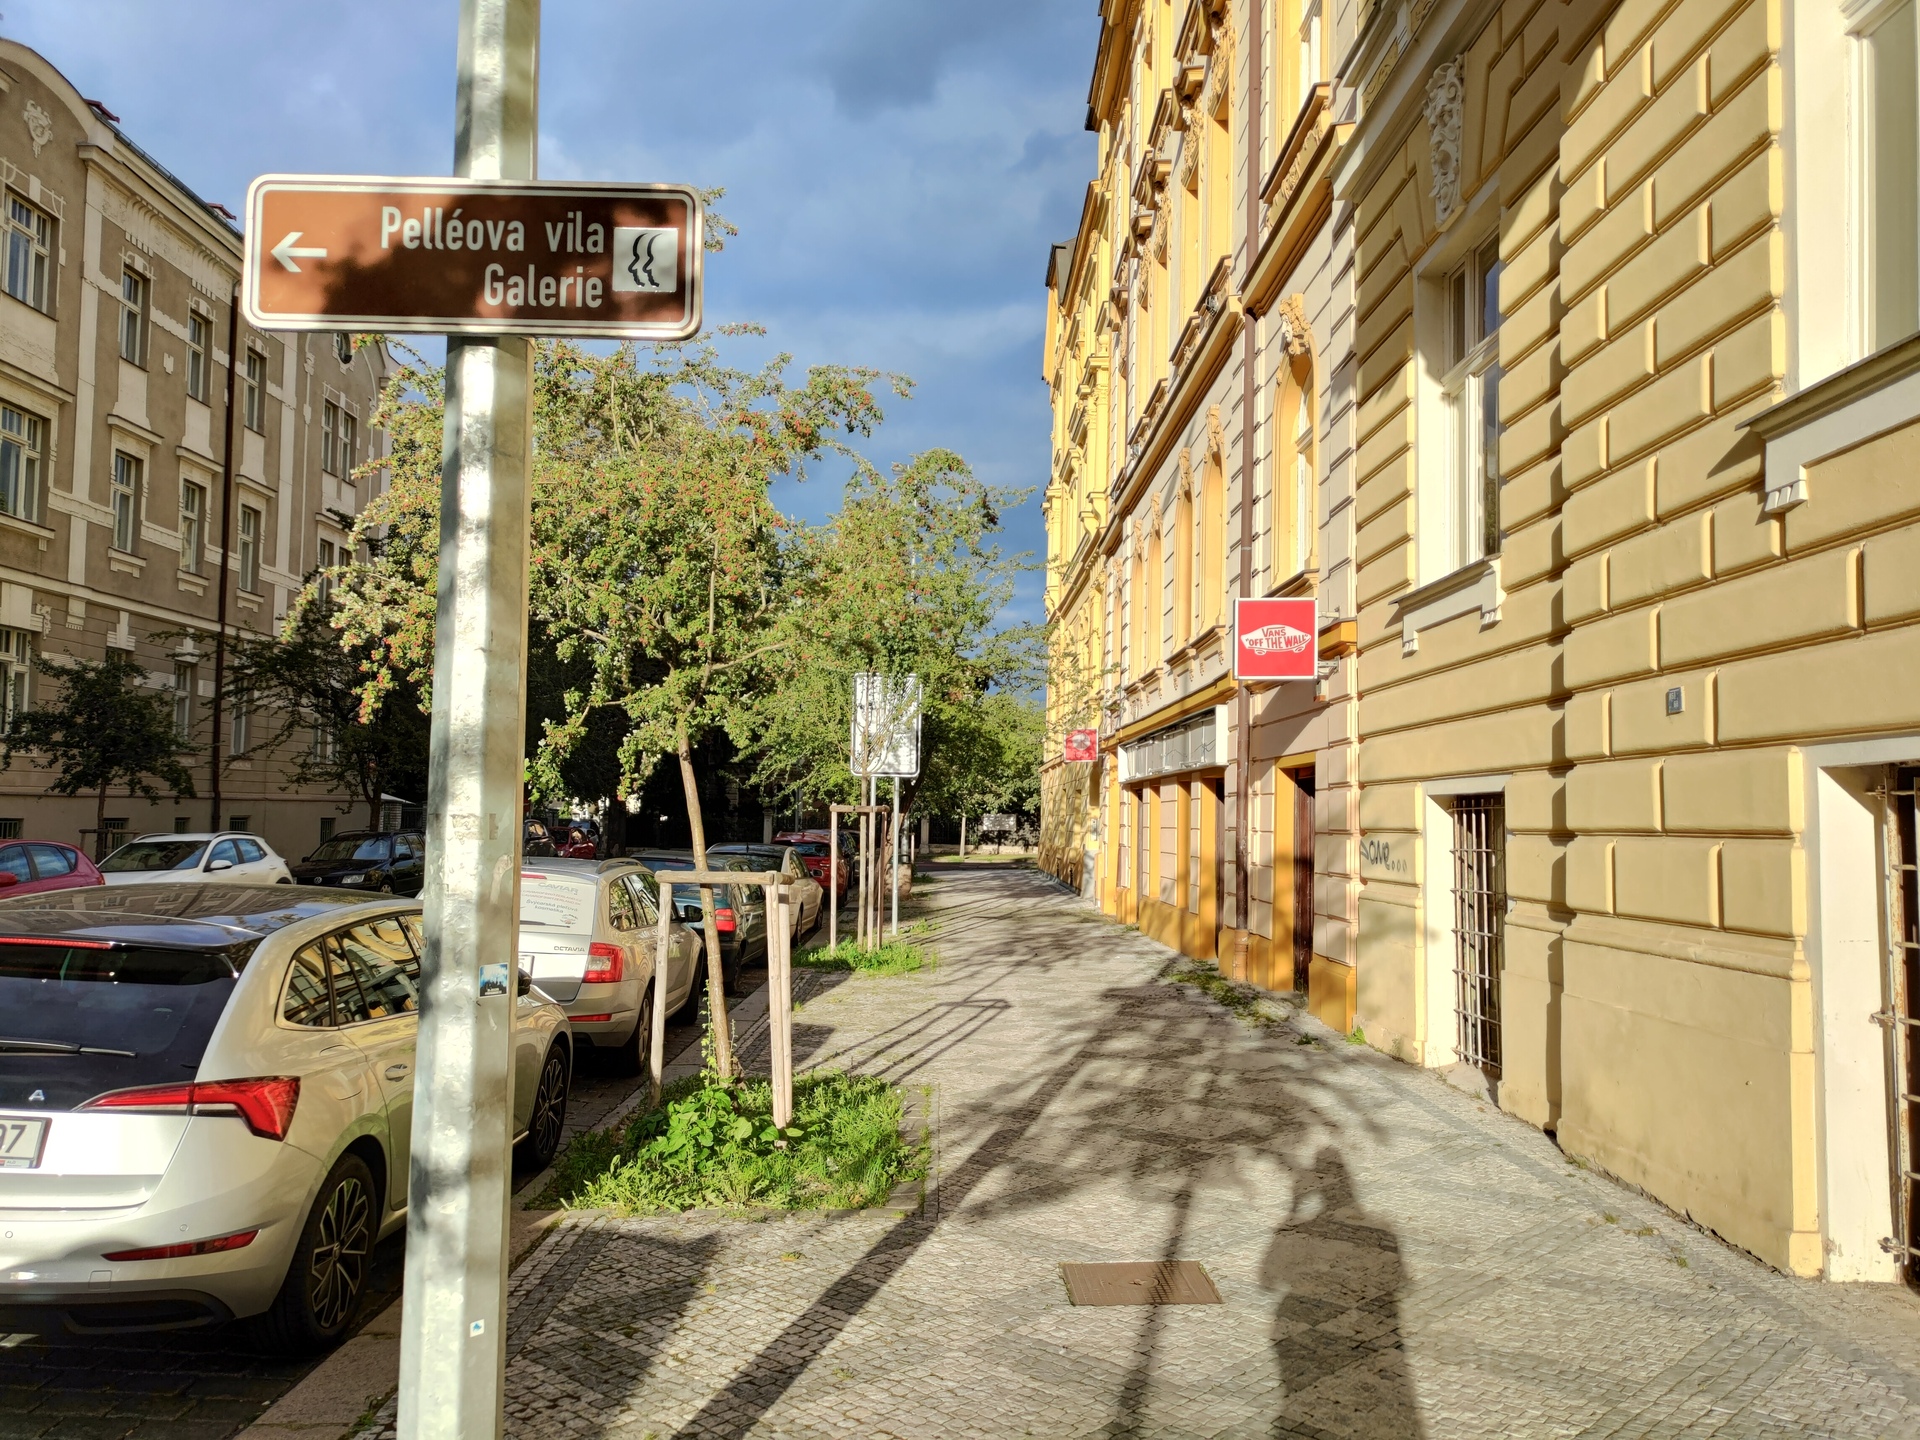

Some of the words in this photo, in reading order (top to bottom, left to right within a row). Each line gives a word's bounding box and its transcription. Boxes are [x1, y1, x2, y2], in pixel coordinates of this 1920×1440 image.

[380, 205, 525, 253] Pelléova
[544, 210, 605, 254] vila
[483, 262, 604, 308] Galerie
[1261, 626, 1287, 637] VANS
[1265, 636, 1284, 649] THE
[538, 882, 579, 893] CAVIAR
